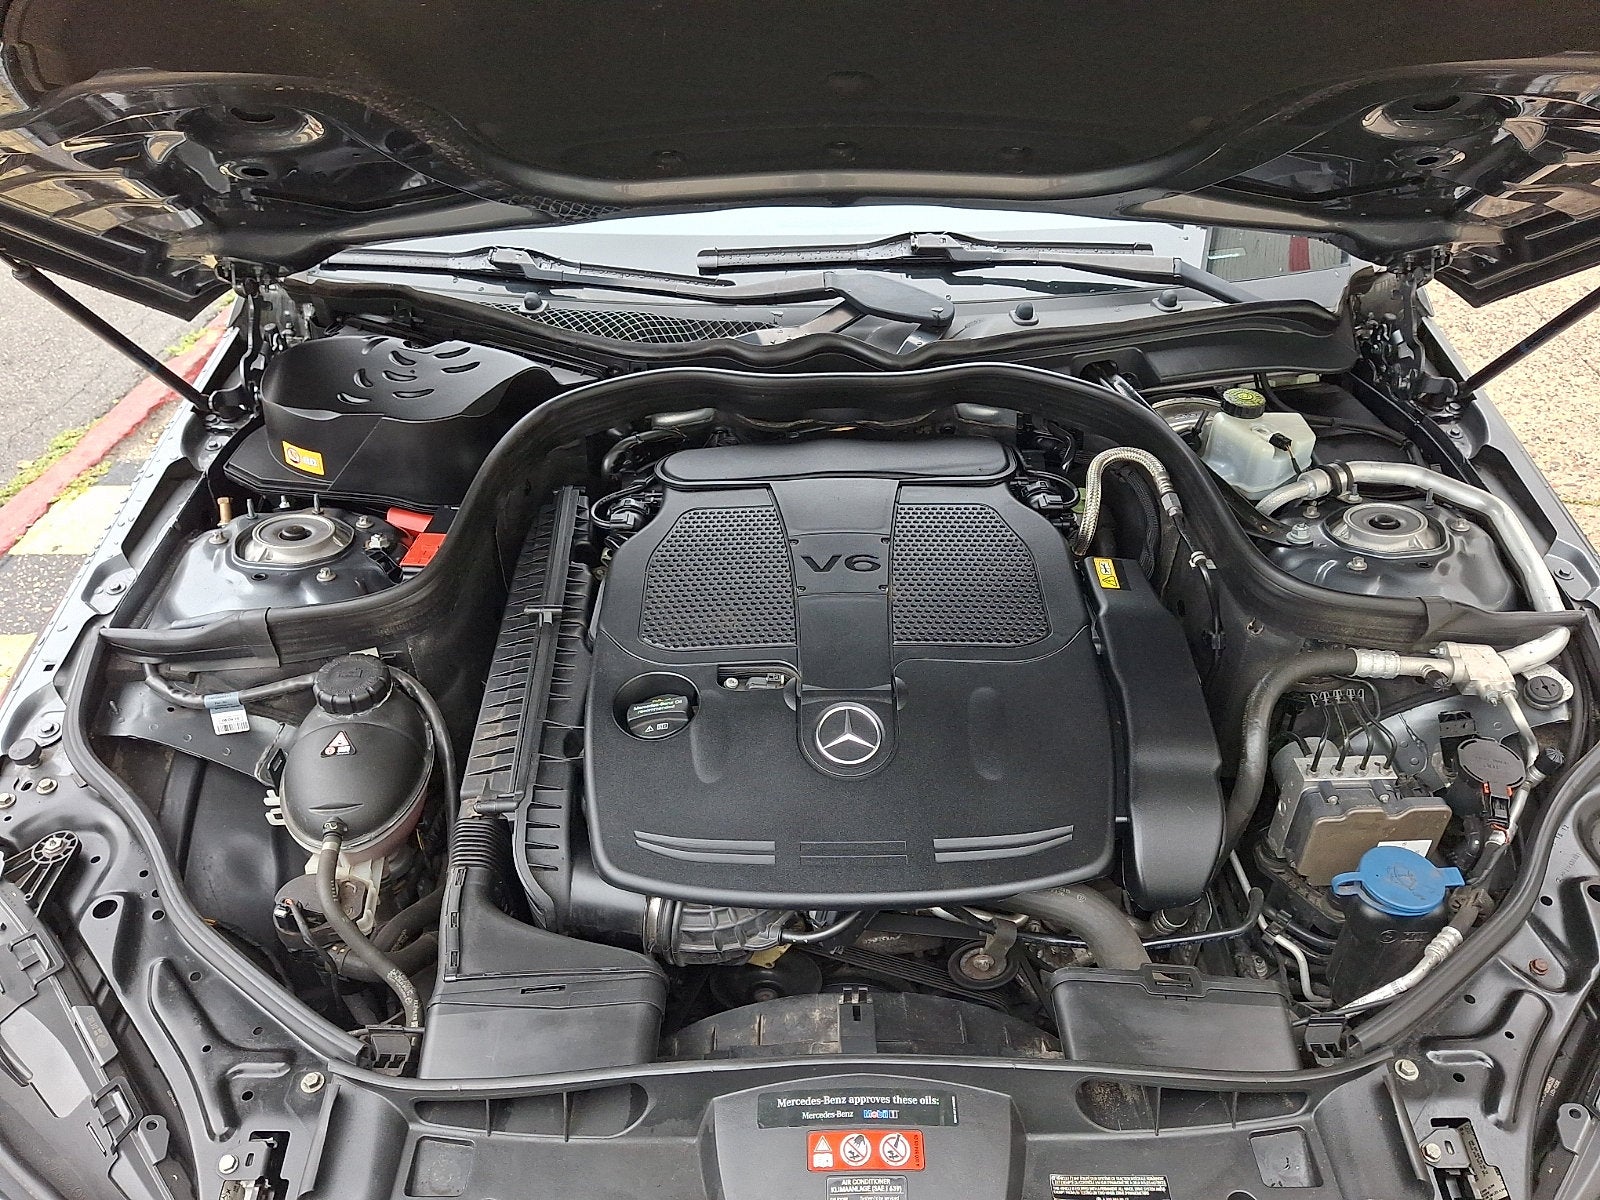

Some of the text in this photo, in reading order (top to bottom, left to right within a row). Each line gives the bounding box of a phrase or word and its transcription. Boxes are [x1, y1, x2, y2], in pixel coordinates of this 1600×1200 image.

[801, 554, 881, 572] V6
[776, 1094, 940, 1108] Mercedes-Benz approves these oils:
[802, 1110, 854, 1120] Mercedes-Benz
[863, 1109, 888, 1119] Mobil
[852, 1178, 891, 1186] CONDITIONER
